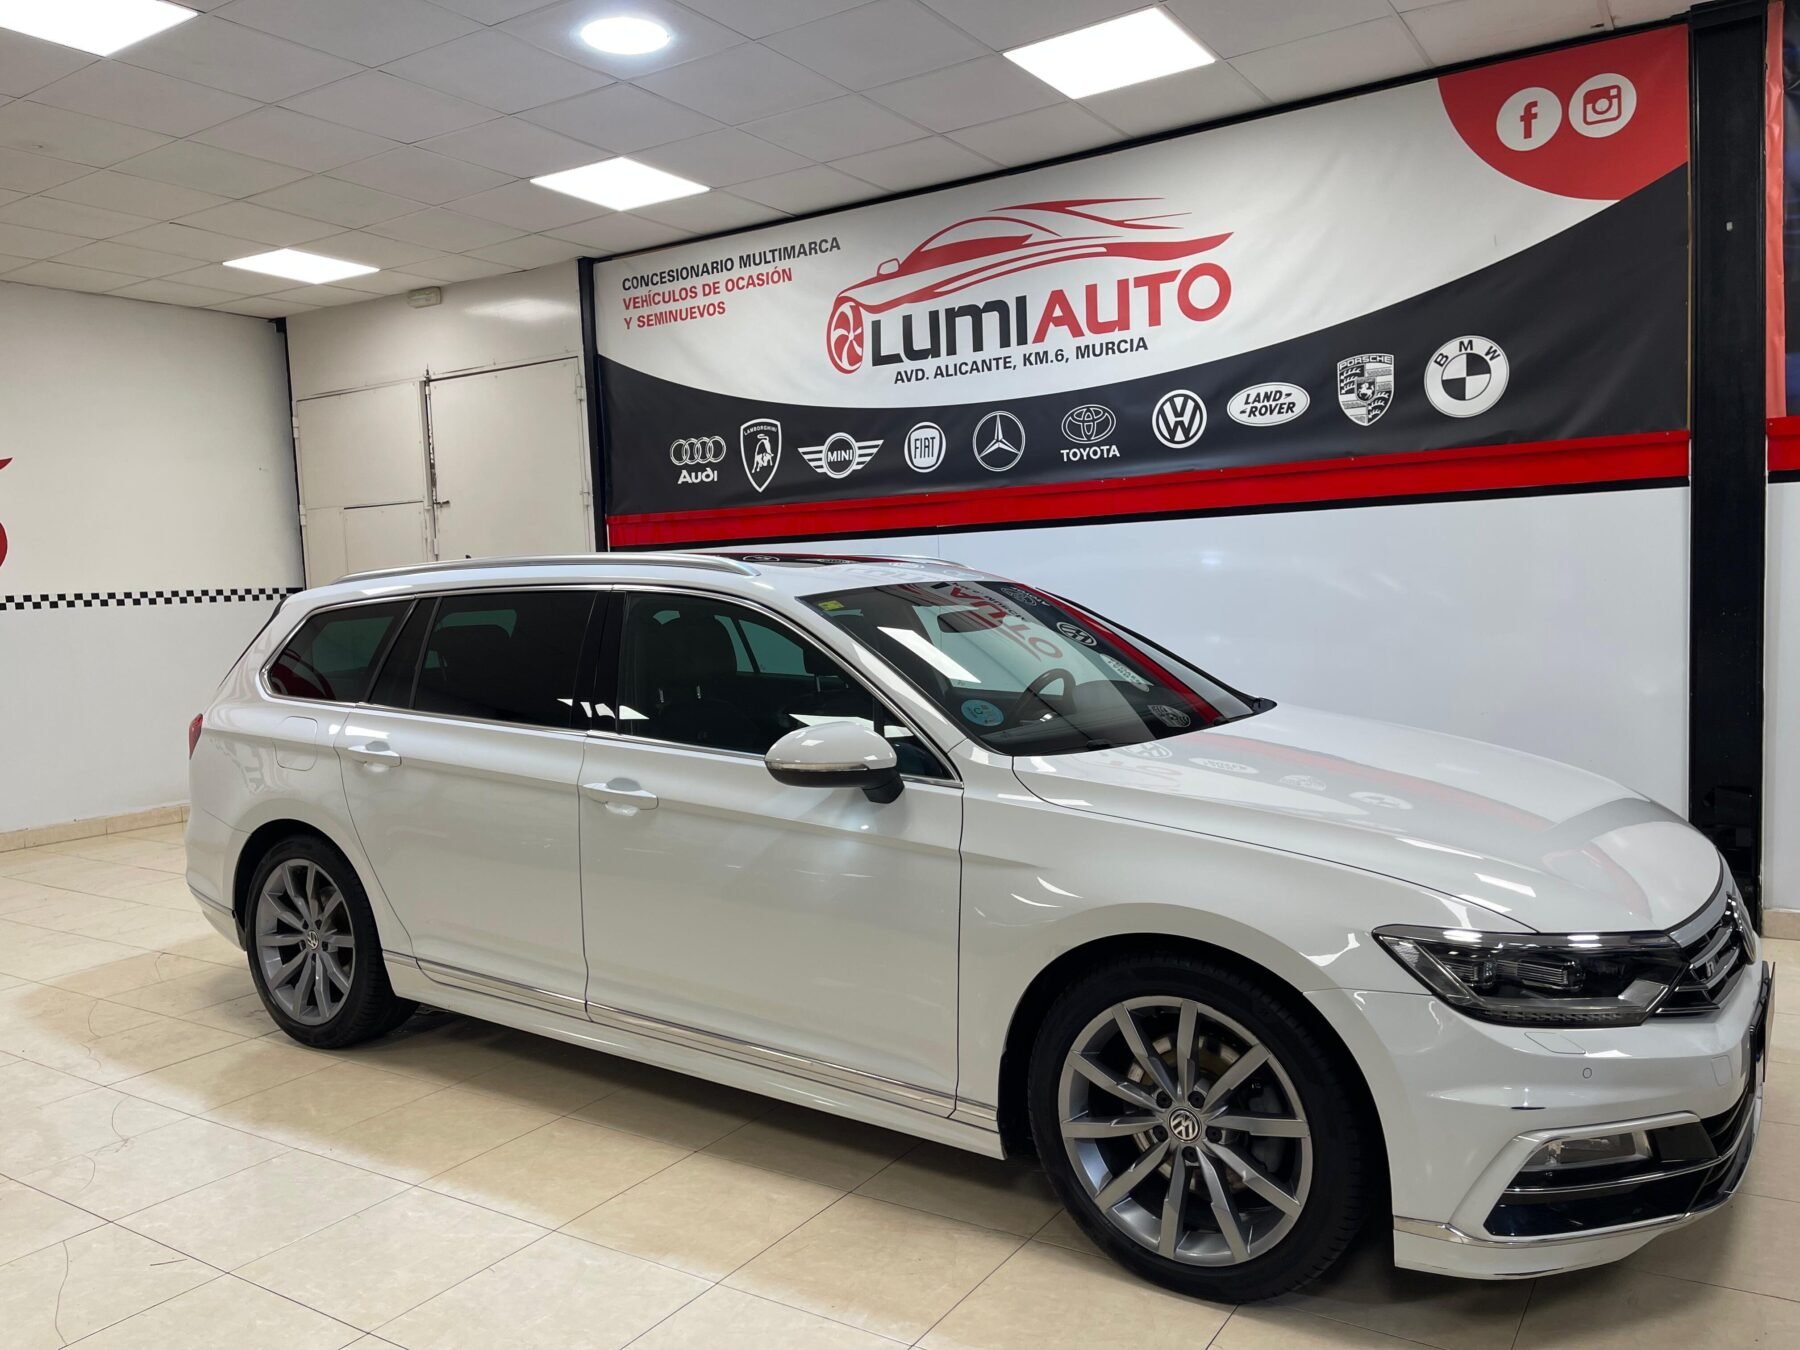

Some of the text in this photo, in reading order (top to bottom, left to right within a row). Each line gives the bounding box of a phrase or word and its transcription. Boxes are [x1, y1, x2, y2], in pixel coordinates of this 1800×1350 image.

[622, 237, 841, 291] CONCESIONARIO MULTIMARCA
[623, 266, 793, 311] VEHÍCULOS DE OCASIÓN
[624, 301, 726, 330] Y SEMINUEVOS
[894, 337, 1148, 385] AVD. ALICANTE, KM.6, MURCIA
[1340, 355, 1392, 370] PORSCHE
[1433, 339, 1501, 368] BMW
[1248, 402, 1296, 418] ROVER
[827, 449, 852, 463] MINI
[914, 437, 936, 460] FIAT
[1060, 445, 1120, 462] TOYOTA
[677, 469, 718, 484] Audi
